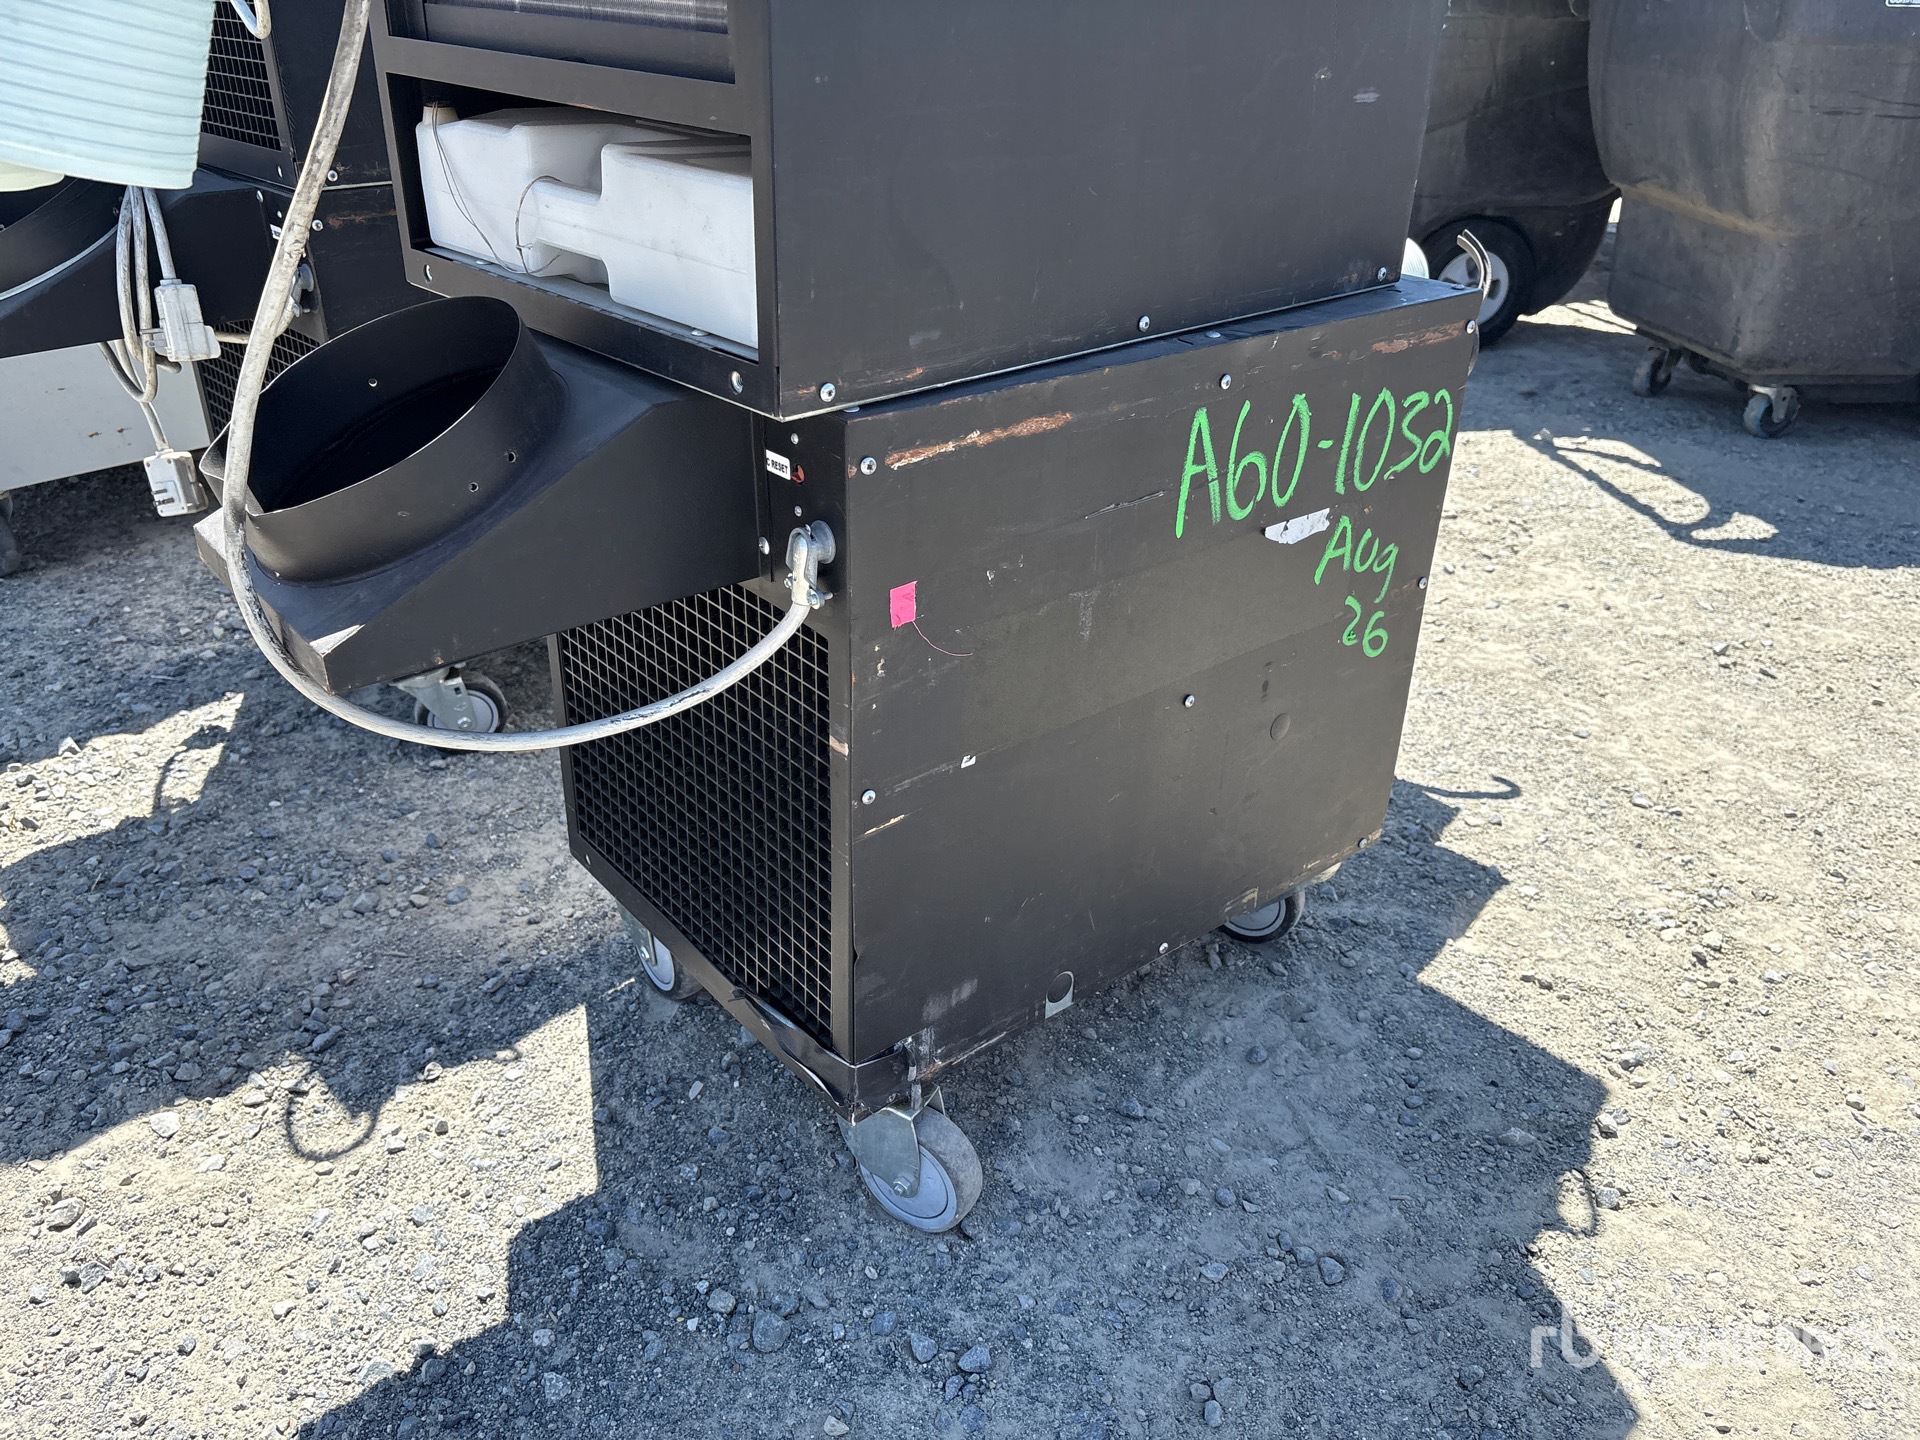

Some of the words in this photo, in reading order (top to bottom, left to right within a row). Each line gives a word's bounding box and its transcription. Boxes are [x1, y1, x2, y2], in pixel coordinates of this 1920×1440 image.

[771, 459, 788, 475] RESET
[1175, 388, 1454, 538] A60-1032
[1342, 595, 1389, 658] 26
